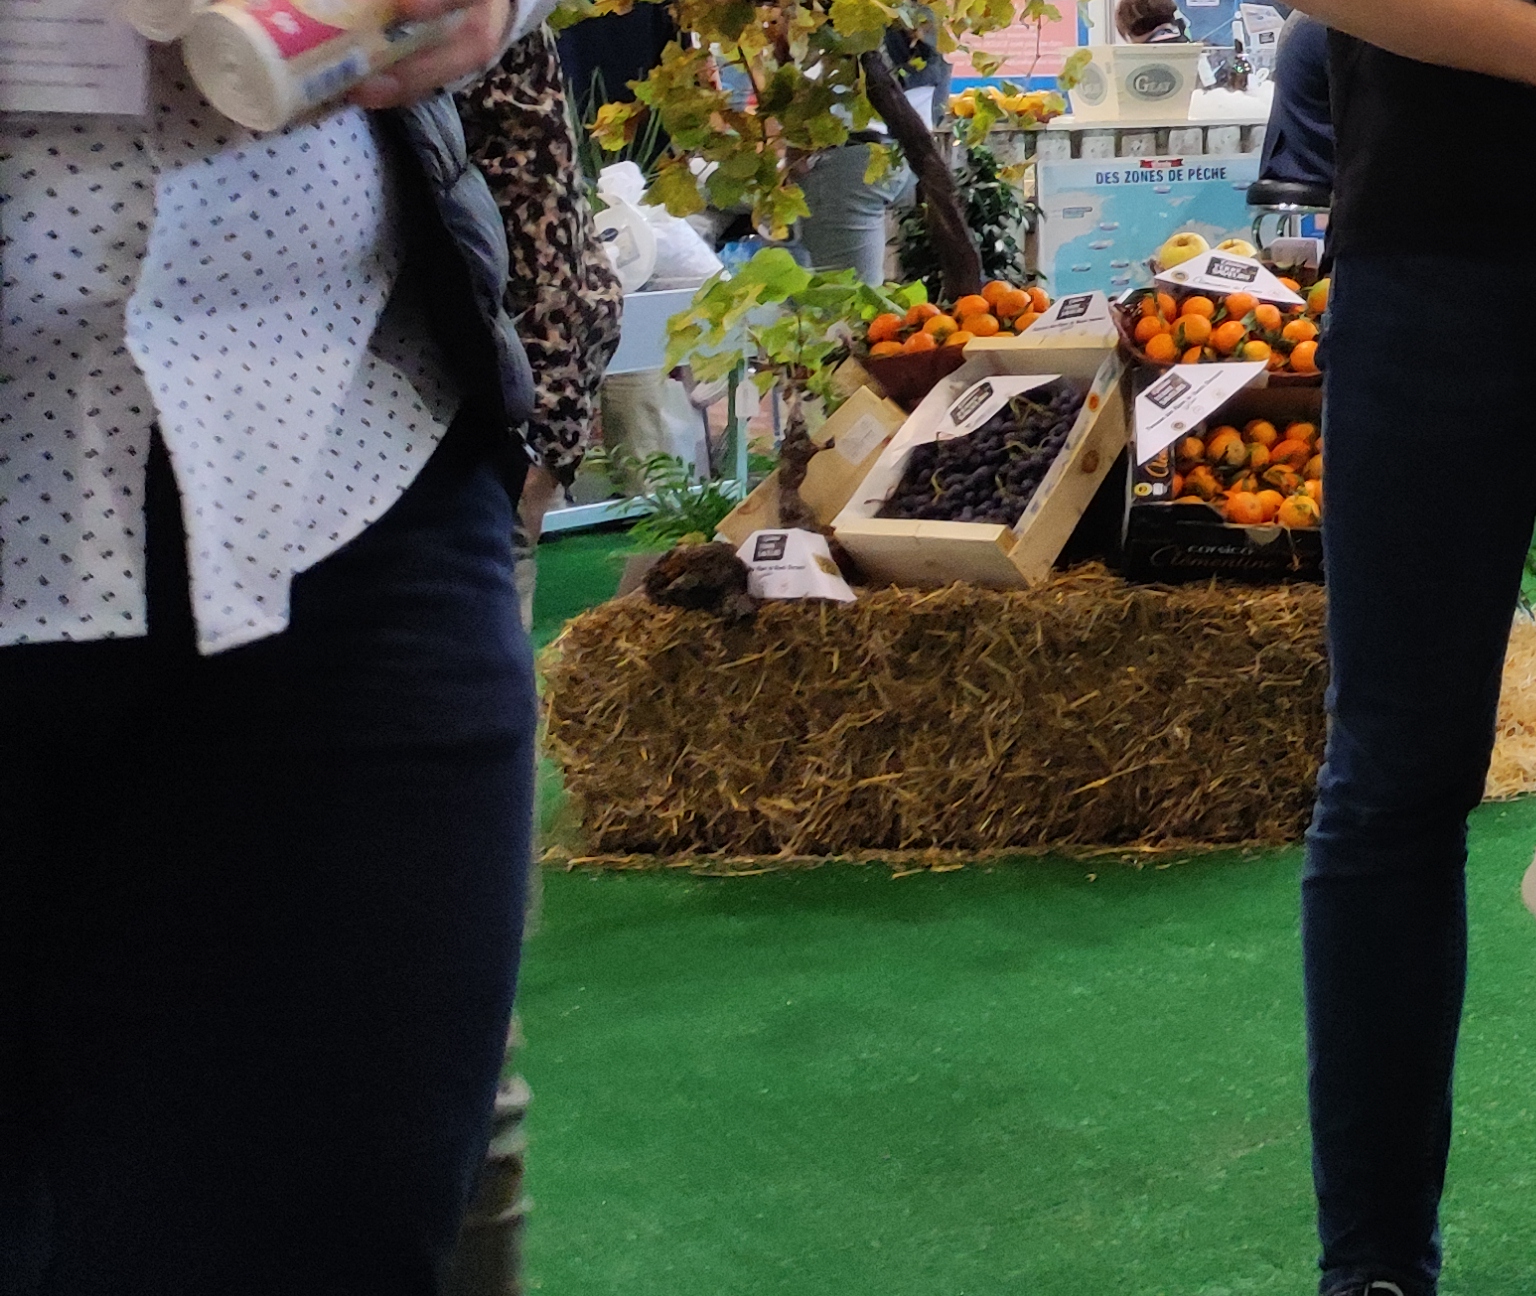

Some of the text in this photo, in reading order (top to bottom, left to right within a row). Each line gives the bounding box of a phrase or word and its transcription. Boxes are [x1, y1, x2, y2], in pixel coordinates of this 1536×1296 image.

[1096, 165, 1227, 185] DES ZONES DE PÊCHE
